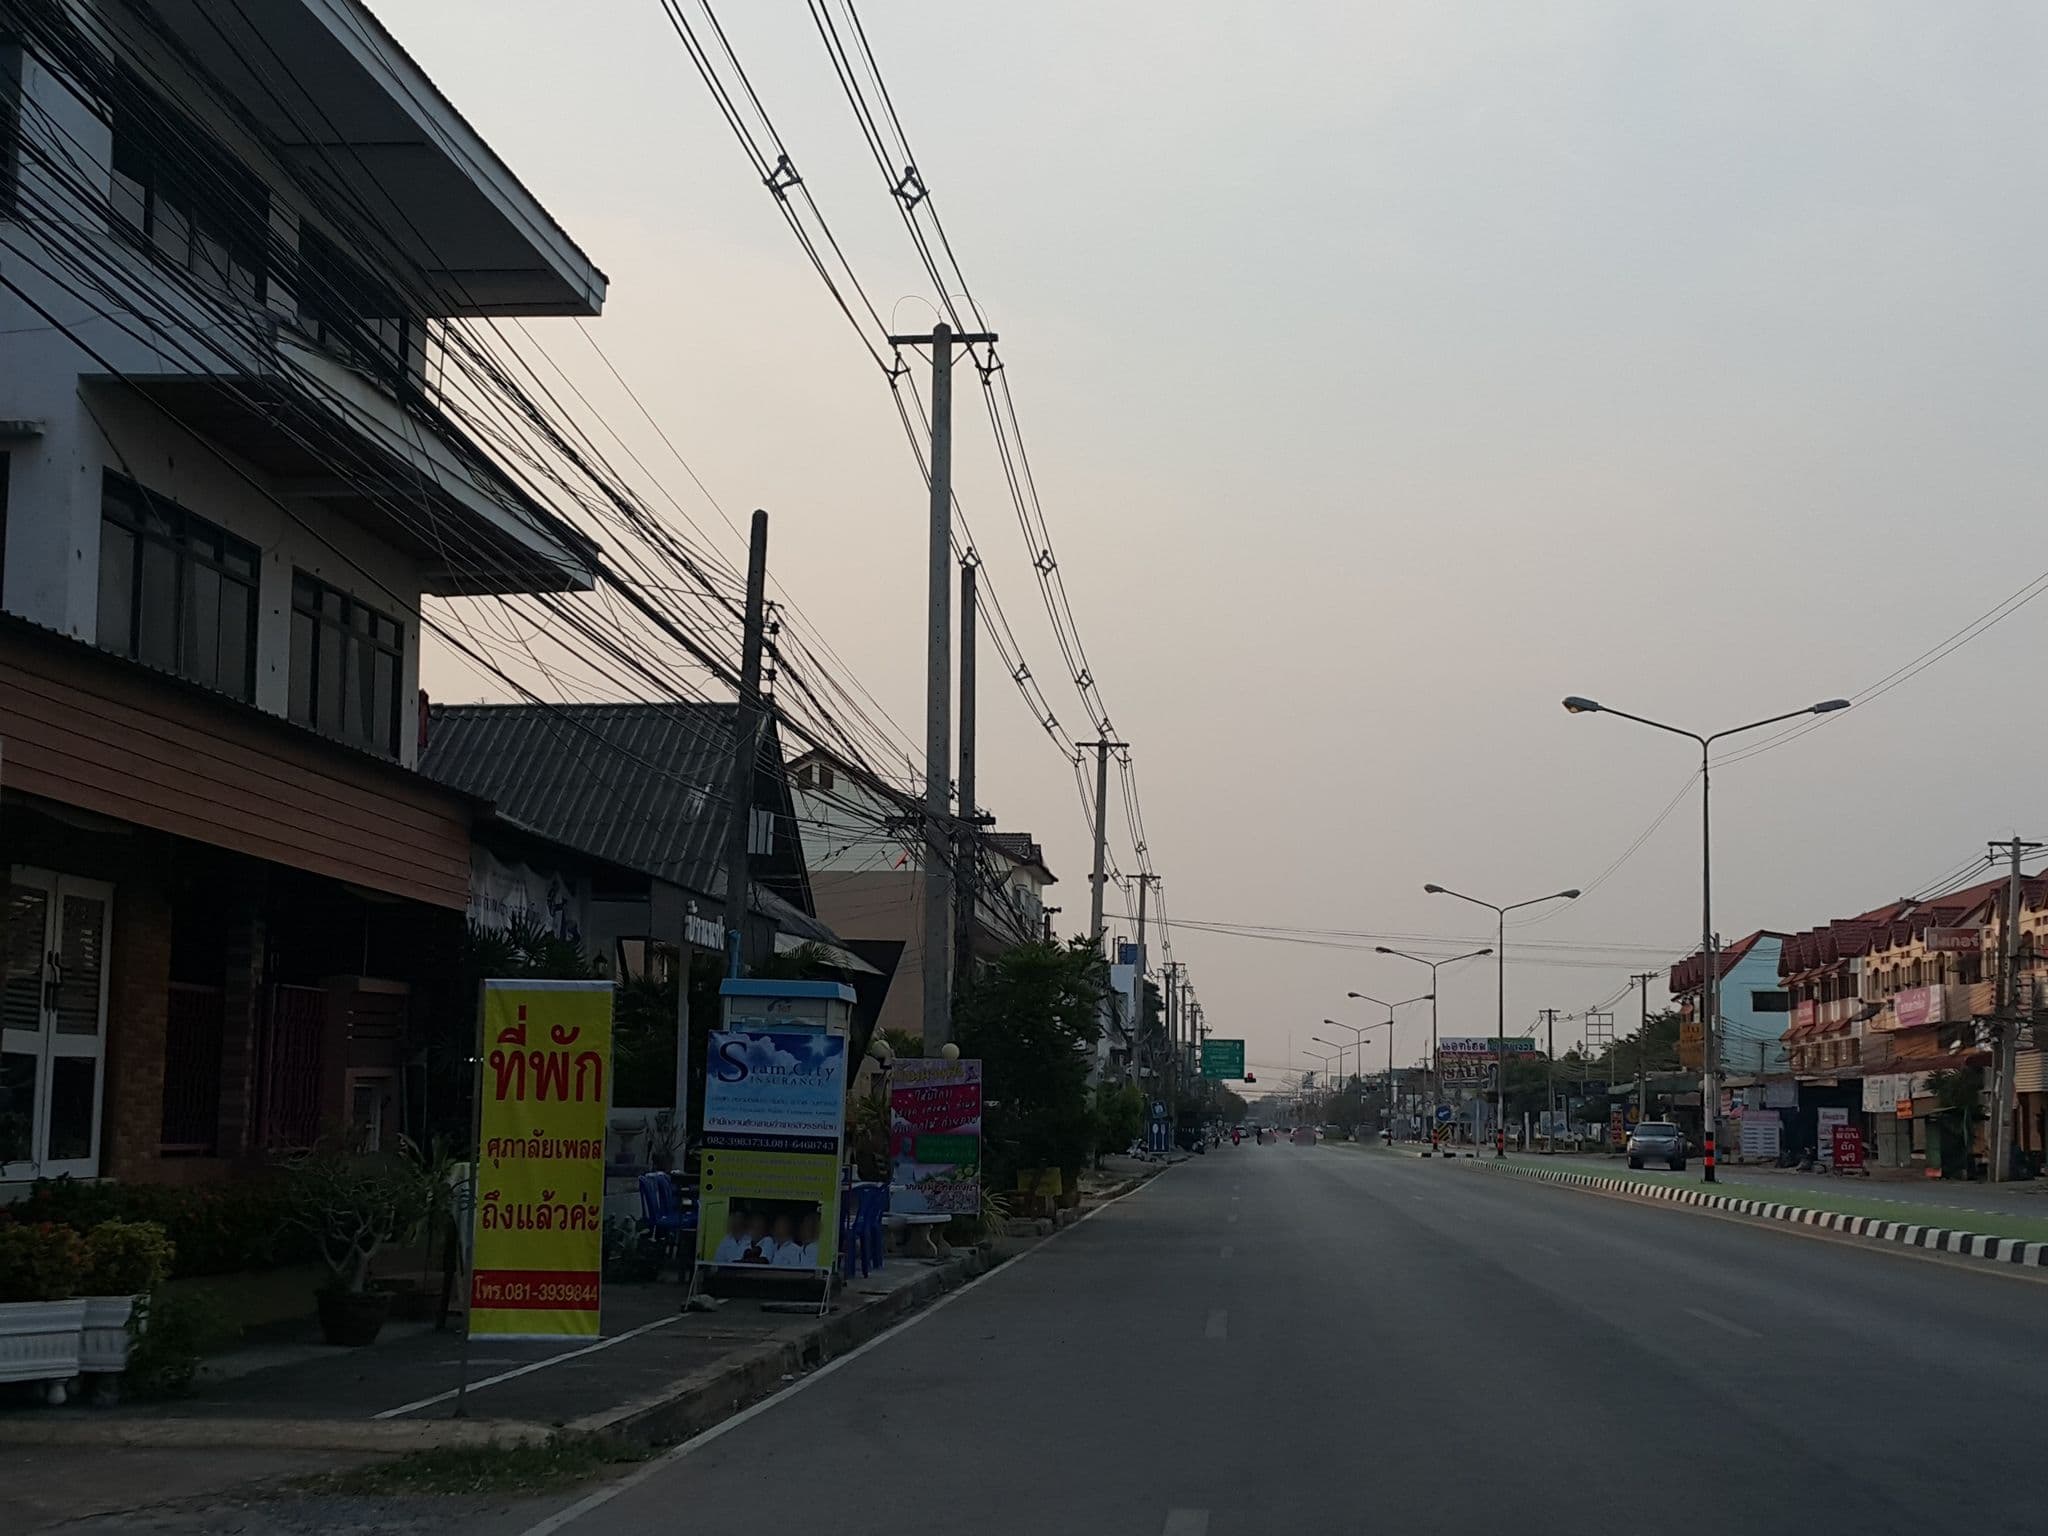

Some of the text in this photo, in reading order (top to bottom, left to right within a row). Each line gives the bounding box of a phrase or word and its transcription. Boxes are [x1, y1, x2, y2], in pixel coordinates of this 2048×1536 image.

[489, 1005, 602, 1102] ที่พัก
[717, 1040, 835, 1083] Siam City
[751, 1076, 824, 1088] INSURANCE
[487, 1129, 602, 1168] ศุภาลัยเพลส
[482, 1190, 600, 1230] ถึงแล้วค่ะ
[475, 1275, 598, 1302] โทร.081-3939844
